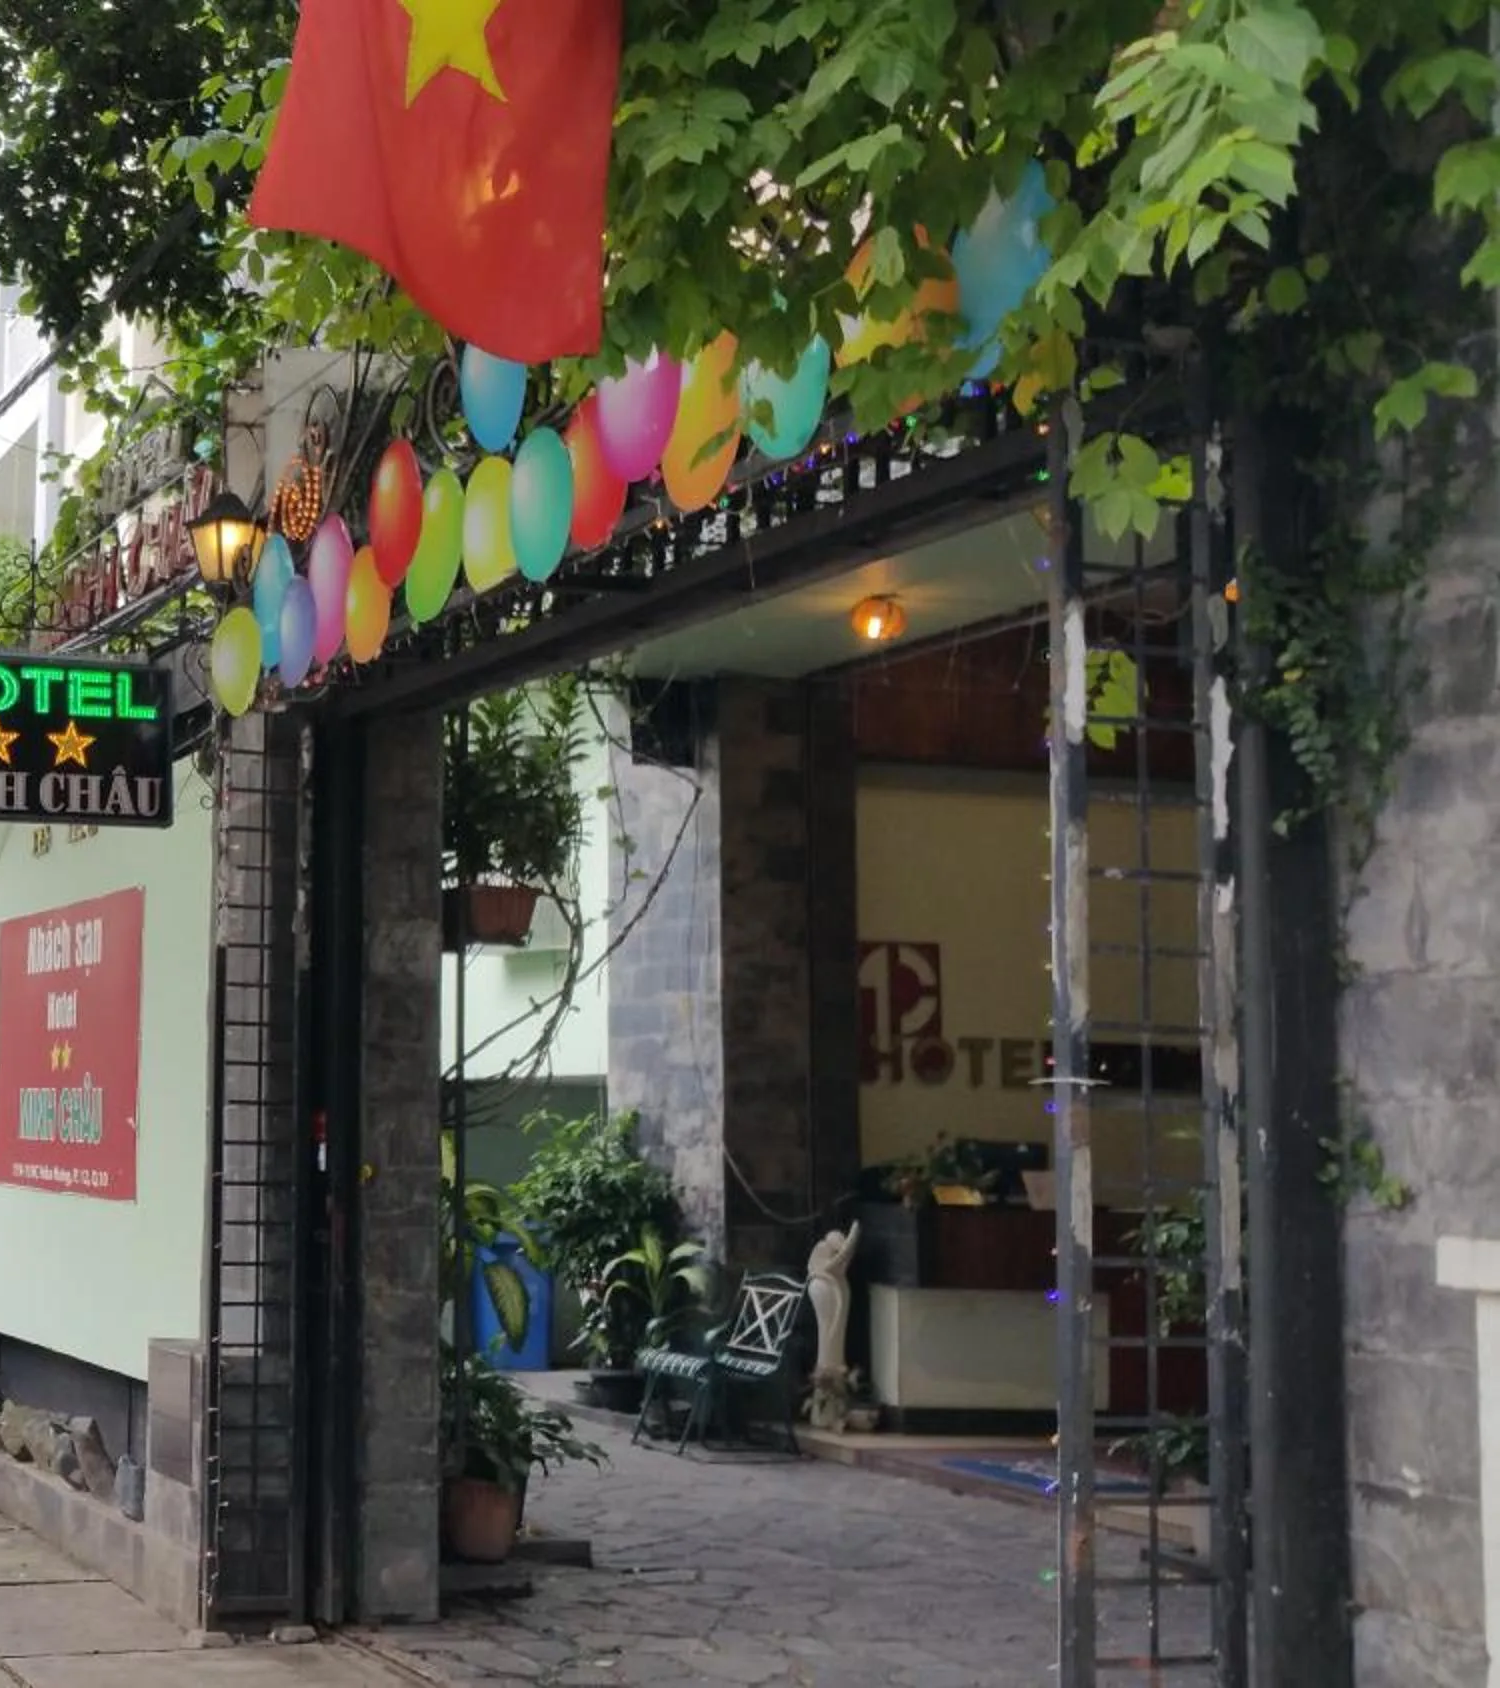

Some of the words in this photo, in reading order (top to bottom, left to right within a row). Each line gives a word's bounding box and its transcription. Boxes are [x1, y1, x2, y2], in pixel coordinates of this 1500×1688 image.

[38, 764, 164, 818] CHÂU
[26, 919, 71, 975] Khách
[75, 918, 102, 977] sạn
